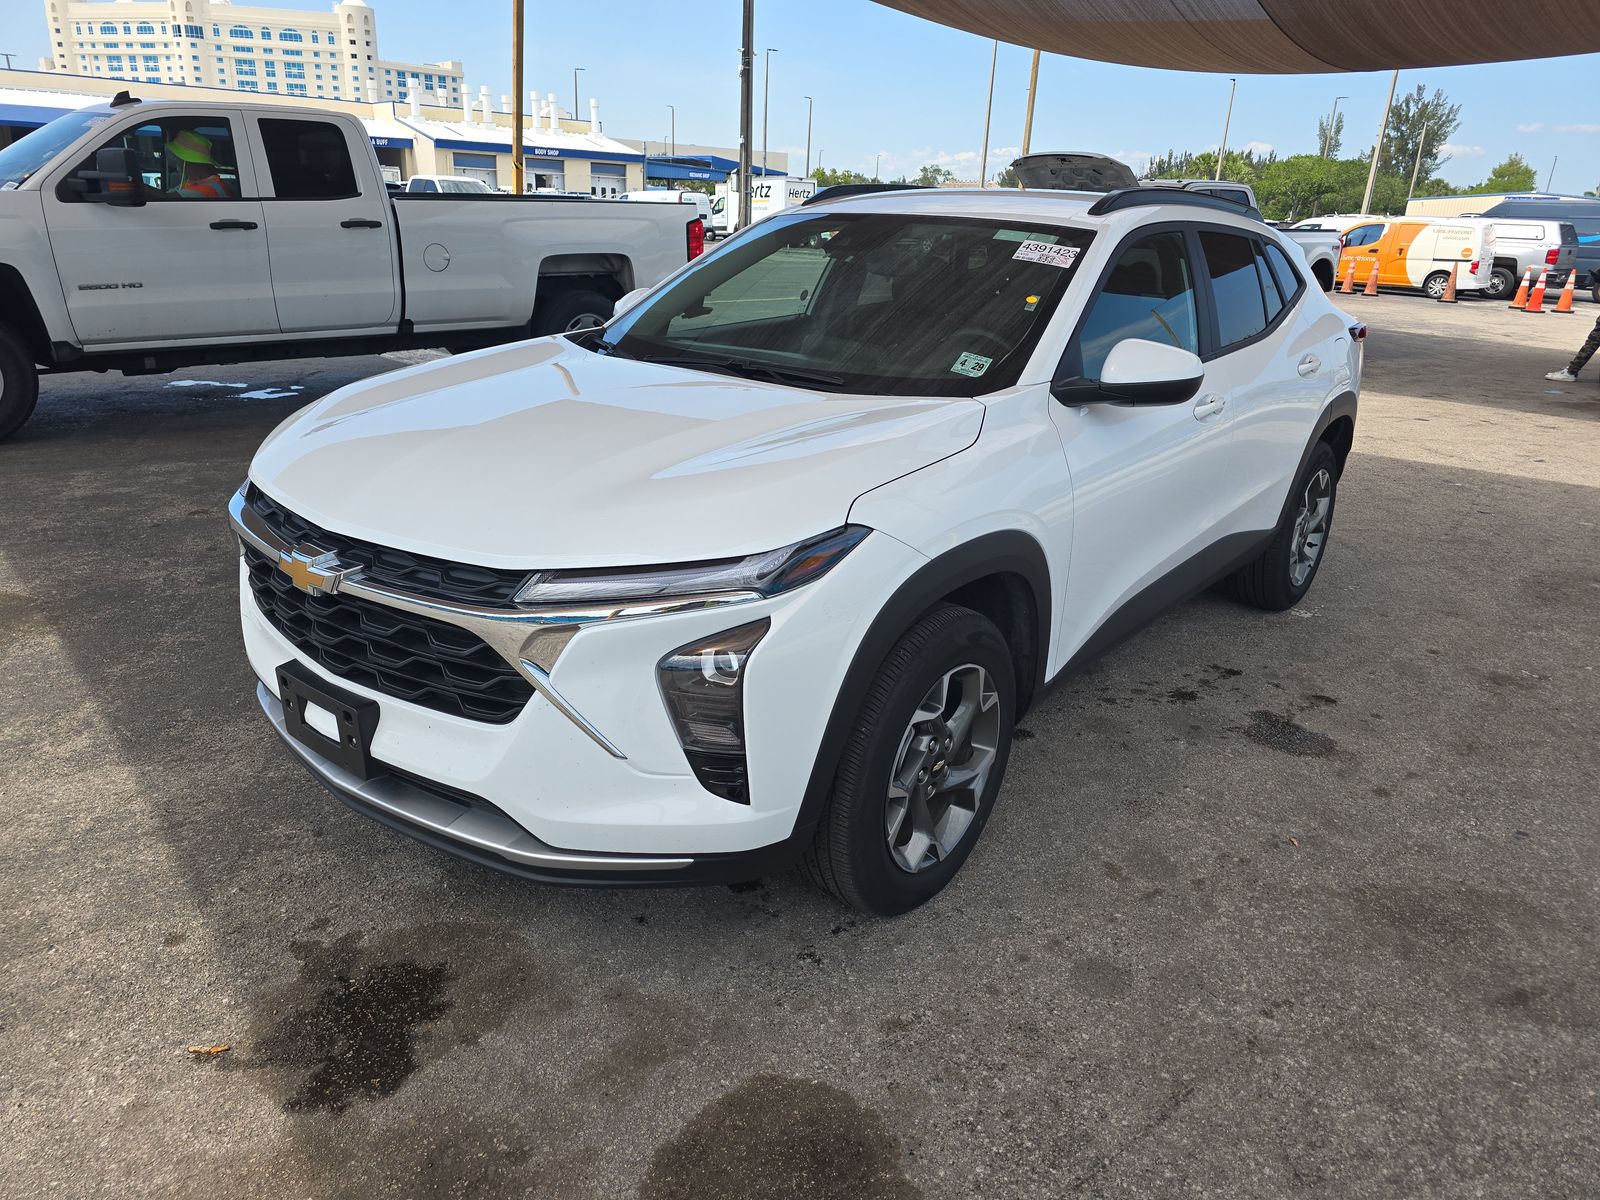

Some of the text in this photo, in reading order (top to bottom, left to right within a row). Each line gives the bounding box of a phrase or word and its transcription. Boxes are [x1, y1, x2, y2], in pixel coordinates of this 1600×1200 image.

[750, 182, 772, 198] ertz
[788, 187, 811, 199] Hertz
[1022, 243, 1079, 259] 4391423
[959, 358, 968, 368] 4
[970, 361, 985, 372] 29
